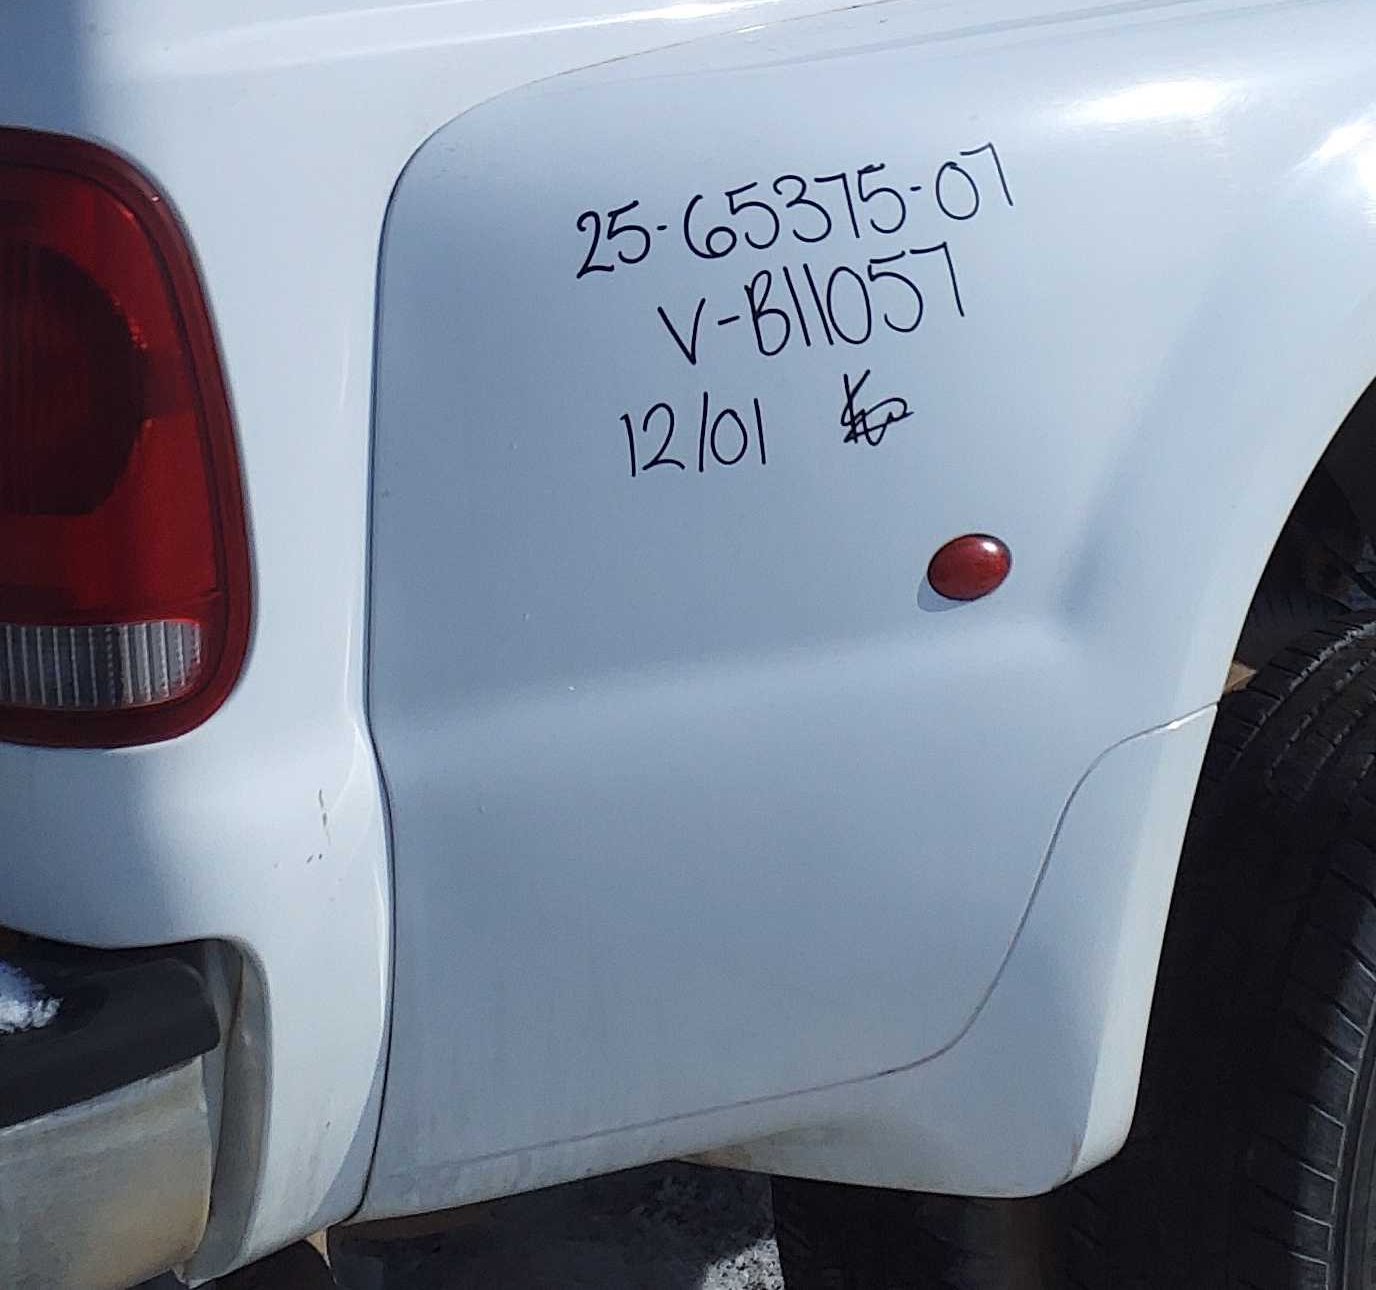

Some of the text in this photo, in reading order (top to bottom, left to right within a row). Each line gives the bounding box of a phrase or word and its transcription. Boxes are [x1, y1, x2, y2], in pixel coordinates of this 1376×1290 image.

[576, 142, 1013, 279] 25-65375-07
[657, 242, 965, 365] V-B11057
[620, 391, 767, 477] 12/01
